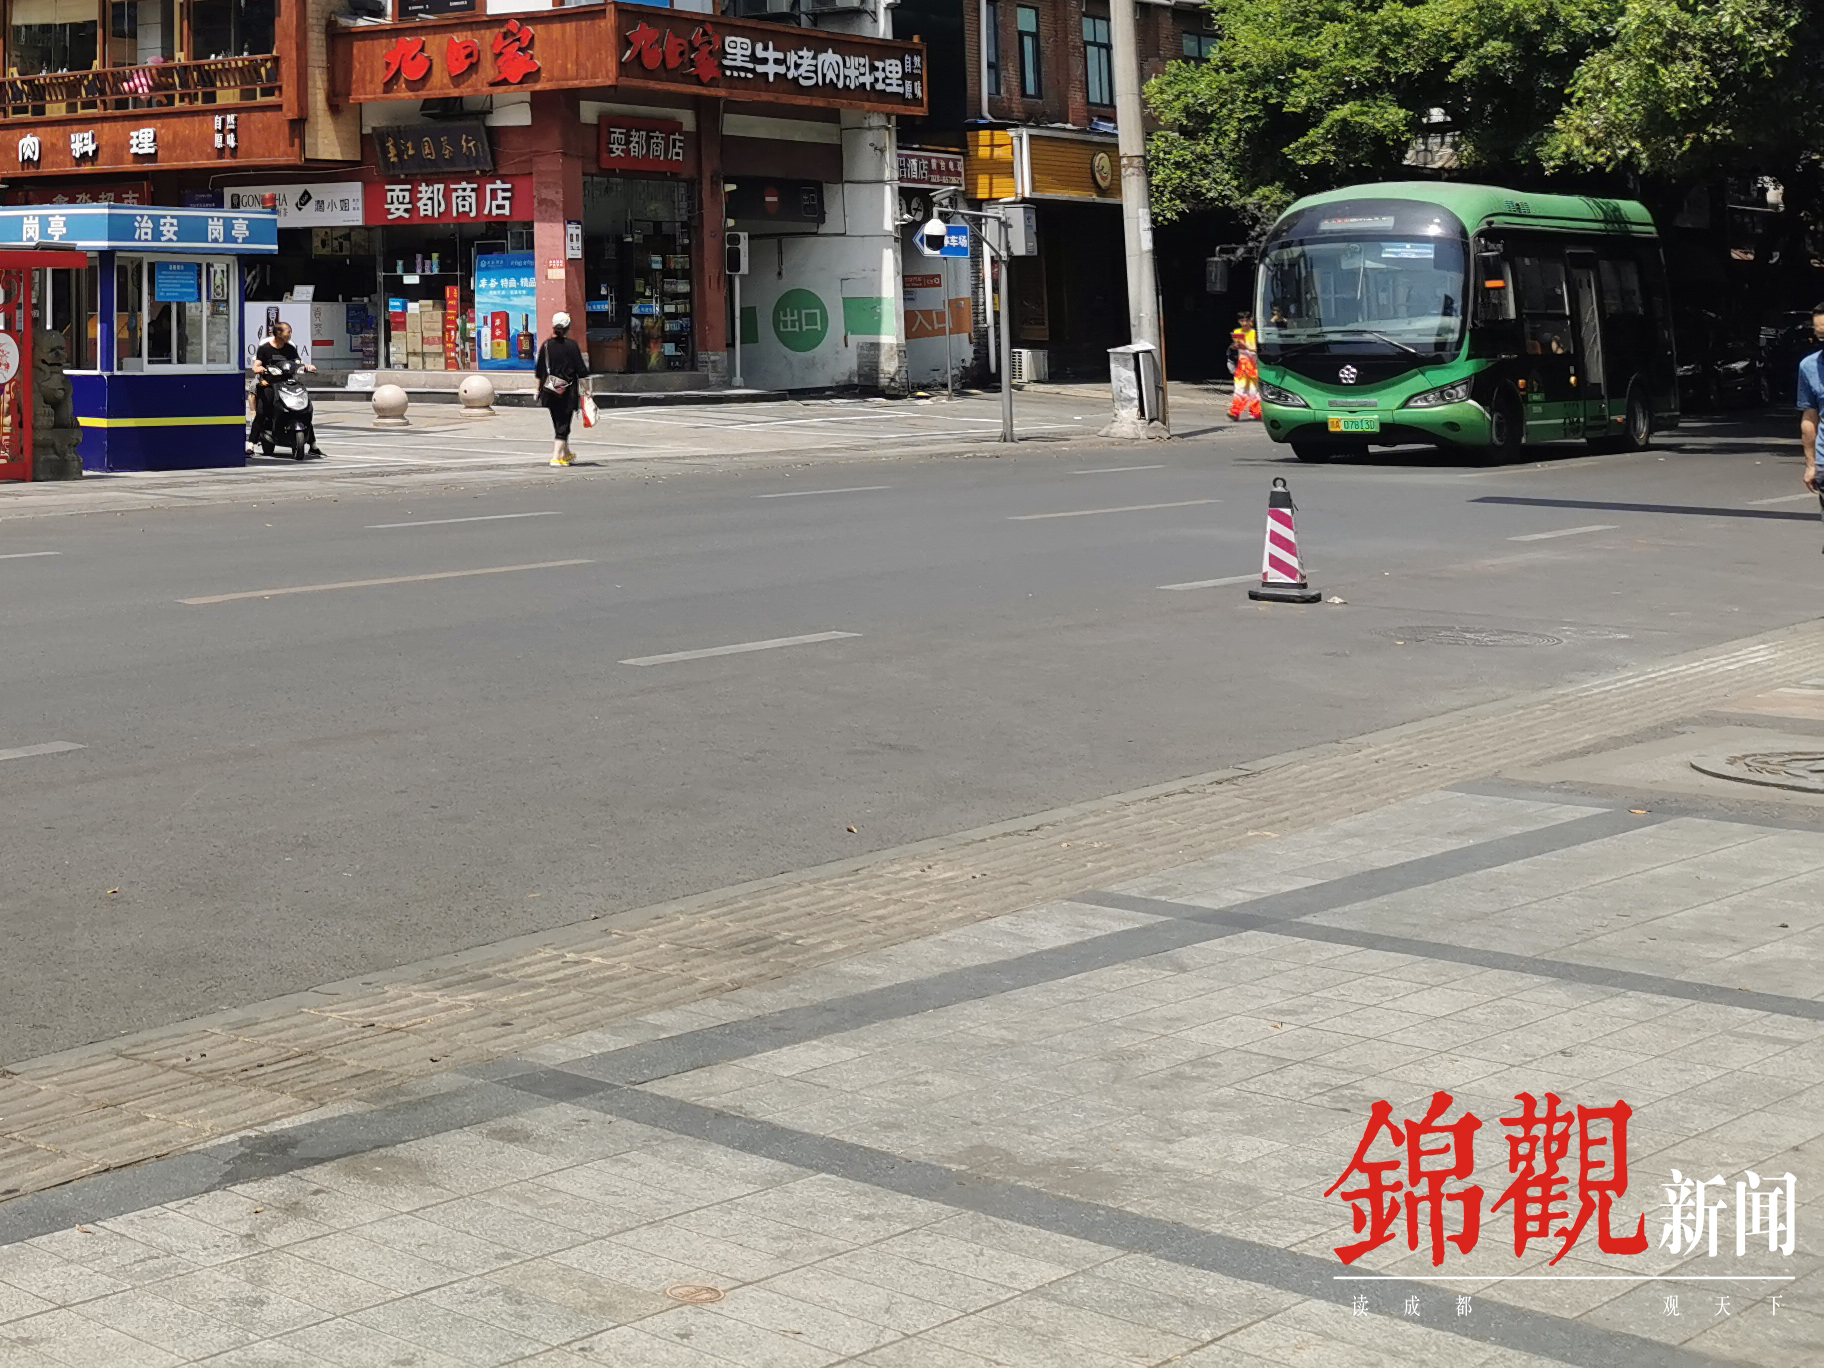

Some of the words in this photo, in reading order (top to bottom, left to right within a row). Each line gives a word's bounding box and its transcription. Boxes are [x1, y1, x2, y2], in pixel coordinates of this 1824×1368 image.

[608, 128, 684, 162] 耍都商店
[384, 180, 513, 219] 耍都商店
[23, 215, 67, 242] 岗亭
[133, 214, 179, 243] 治安
[207, 216, 250, 244] 岗亭
[779, 307, 822, 333] 出口
[911, 310, 953, 333] 入口
